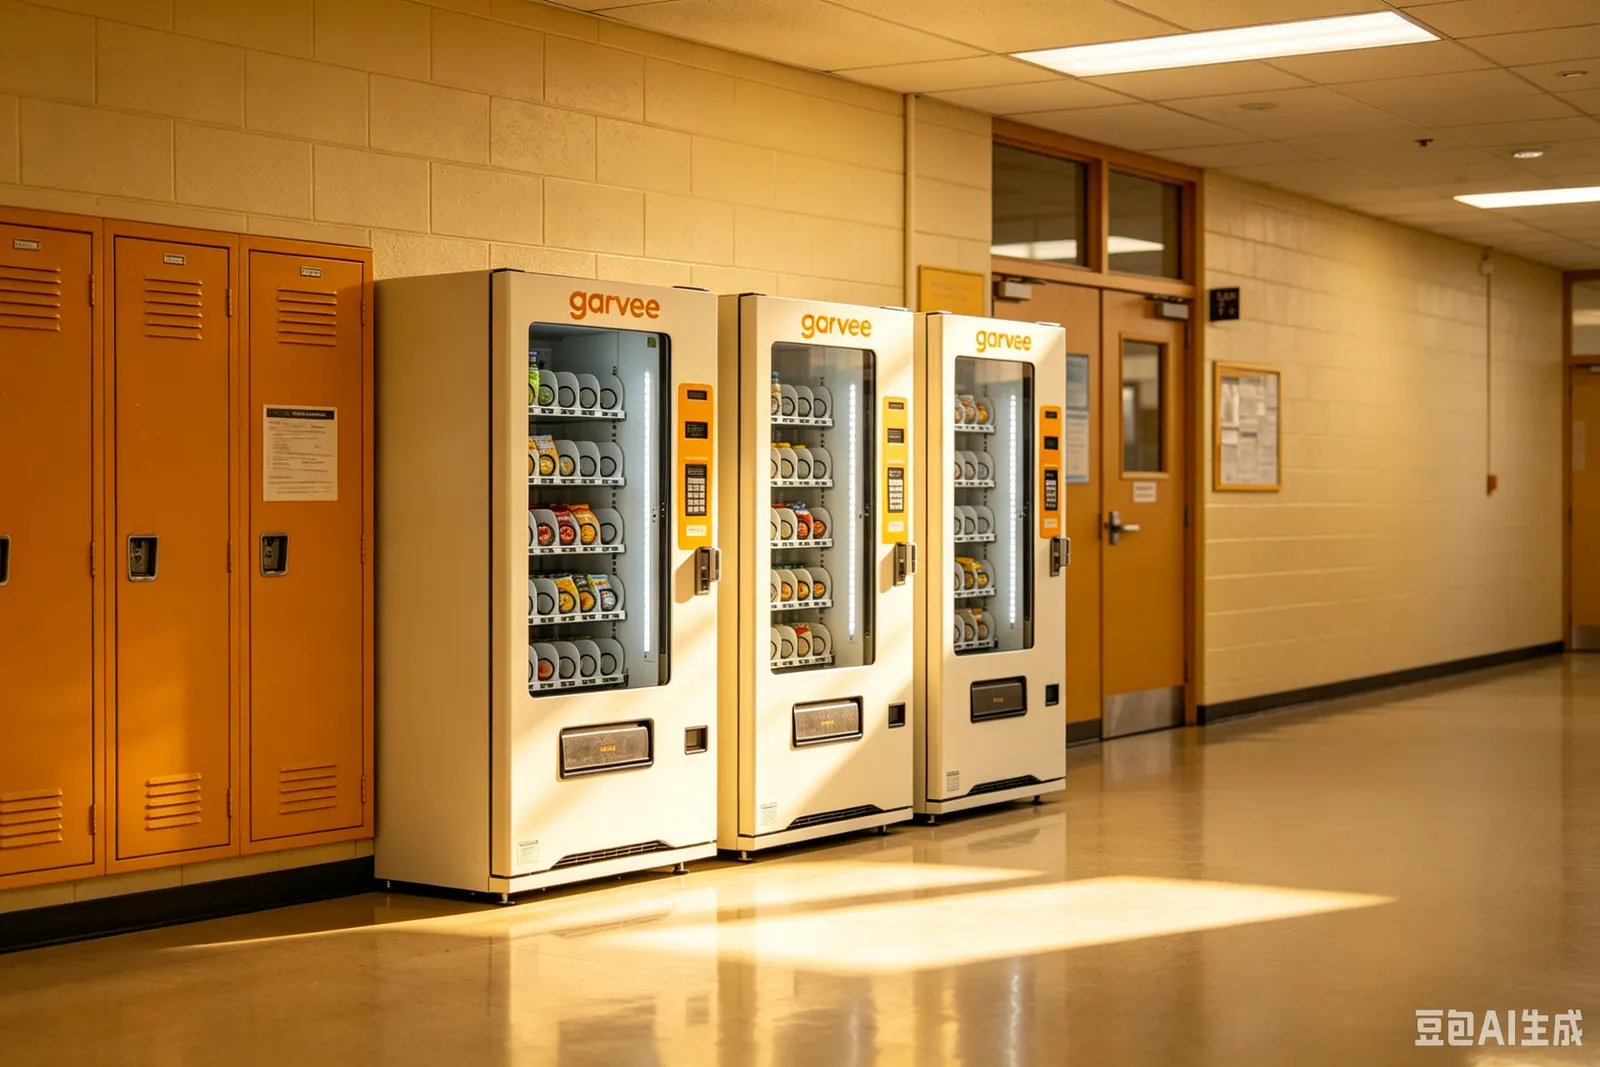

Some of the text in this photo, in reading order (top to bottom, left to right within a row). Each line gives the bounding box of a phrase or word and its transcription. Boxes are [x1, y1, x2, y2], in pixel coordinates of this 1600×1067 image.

[569, 291, 660, 320] garvee
[801, 313, 872, 339] garvee
[975, 330, 1032, 354] garvee
